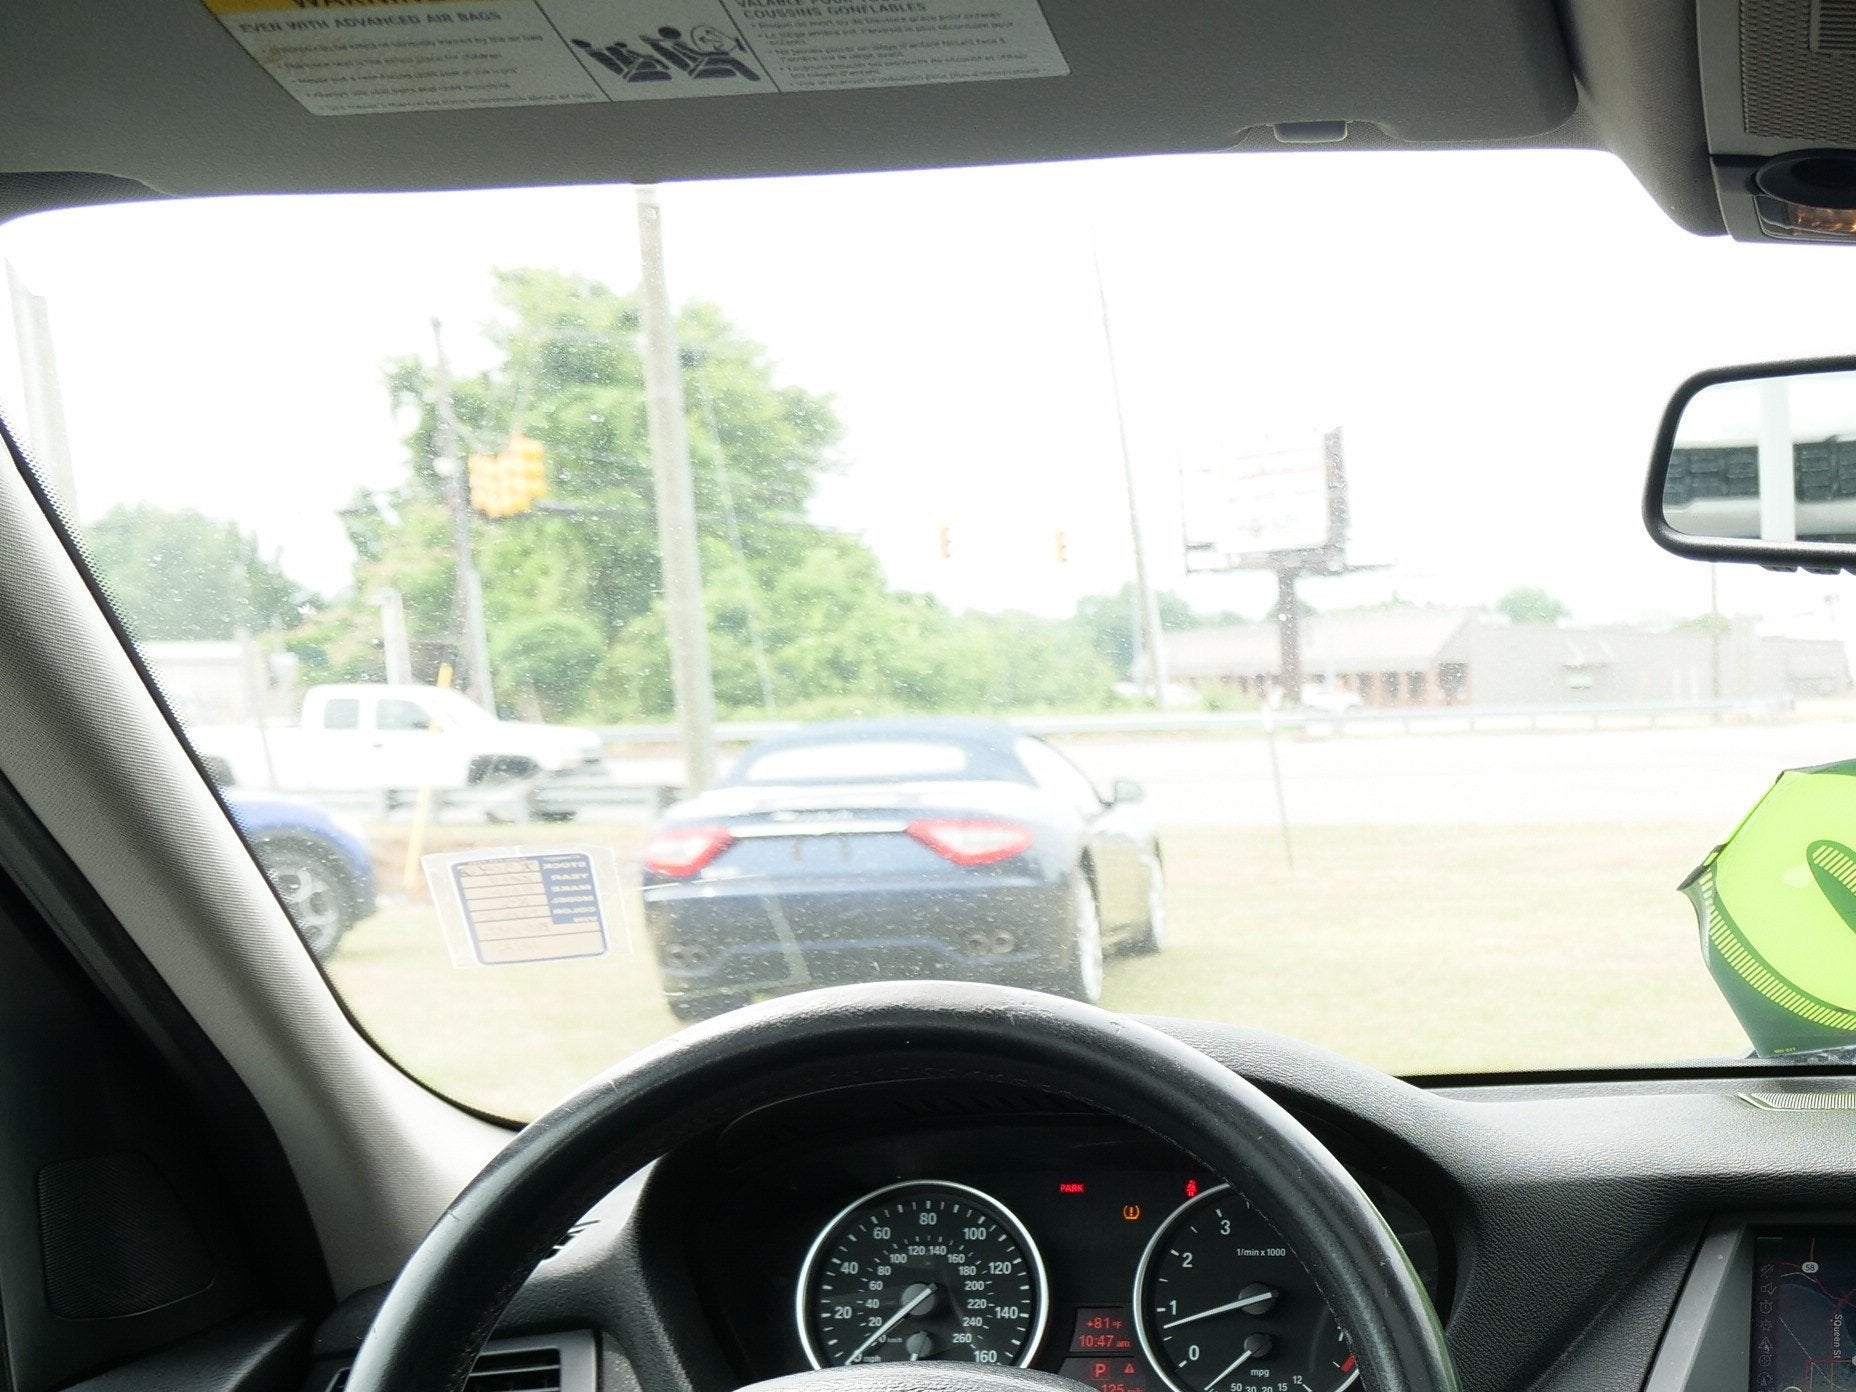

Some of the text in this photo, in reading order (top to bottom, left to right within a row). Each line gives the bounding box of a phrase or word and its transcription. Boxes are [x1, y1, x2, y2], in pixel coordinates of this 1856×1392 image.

[240, 10, 502, 34] EVEN WITH ADVANCED AIR BAGS
[1059, 1184, 1085, 1193] PARK
[919, 1213, 937, 1225] 80
[1220, 1220, 1231, 1235] 3
[873, 1227, 891, 1239] 60
[963, 1227, 987, 1240] 100
[908, 1246, 925, 1255] 120
[929, 1246, 947, 1255] 140
[1236, 1248, 1259, 1257] 1/min
[1267, 1248, 1286, 1257] 1000
[890, 1254, 907, 1264] 100
[948, 1254, 965, 1264] 160
[1182, 1253, 1193, 1267] 2
[841, 1262, 858, 1274] 40
[877, 1266, 891, 1276] 80
[959, 1266, 976, 1276] 180
[989, 1261, 1012, 1275] 120
[869, 1281, 883, 1291] 60
[965, 1281, 984, 1291] 200
[865, 1299, 880, 1309] 40
[967, 1299, 987, 1309] 220
[1169, 1300, 1177, 1315] 1
[834, 1306, 852, 1319] 20
[995, 1306, 1018, 1319] 140
[869, 1317, 883, 1327] 20
[963, 1317, 983, 1327] 240
[953, 1333, 972, 1343] 260
[1079, 1335, 1114, 1347] 10:47
[974, 1350, 997, 1363] 160
[1189, 1345, 1200, 1361] 0
[1094, 1364, 1106, 1377] P
[1250, 1368, 1270, 1377] mpg
[1292, 1375, 1302, 1384] 12
[1231, 1383, 1242, 1392] 50
[1278, 1383, 1288, 1392] 15
